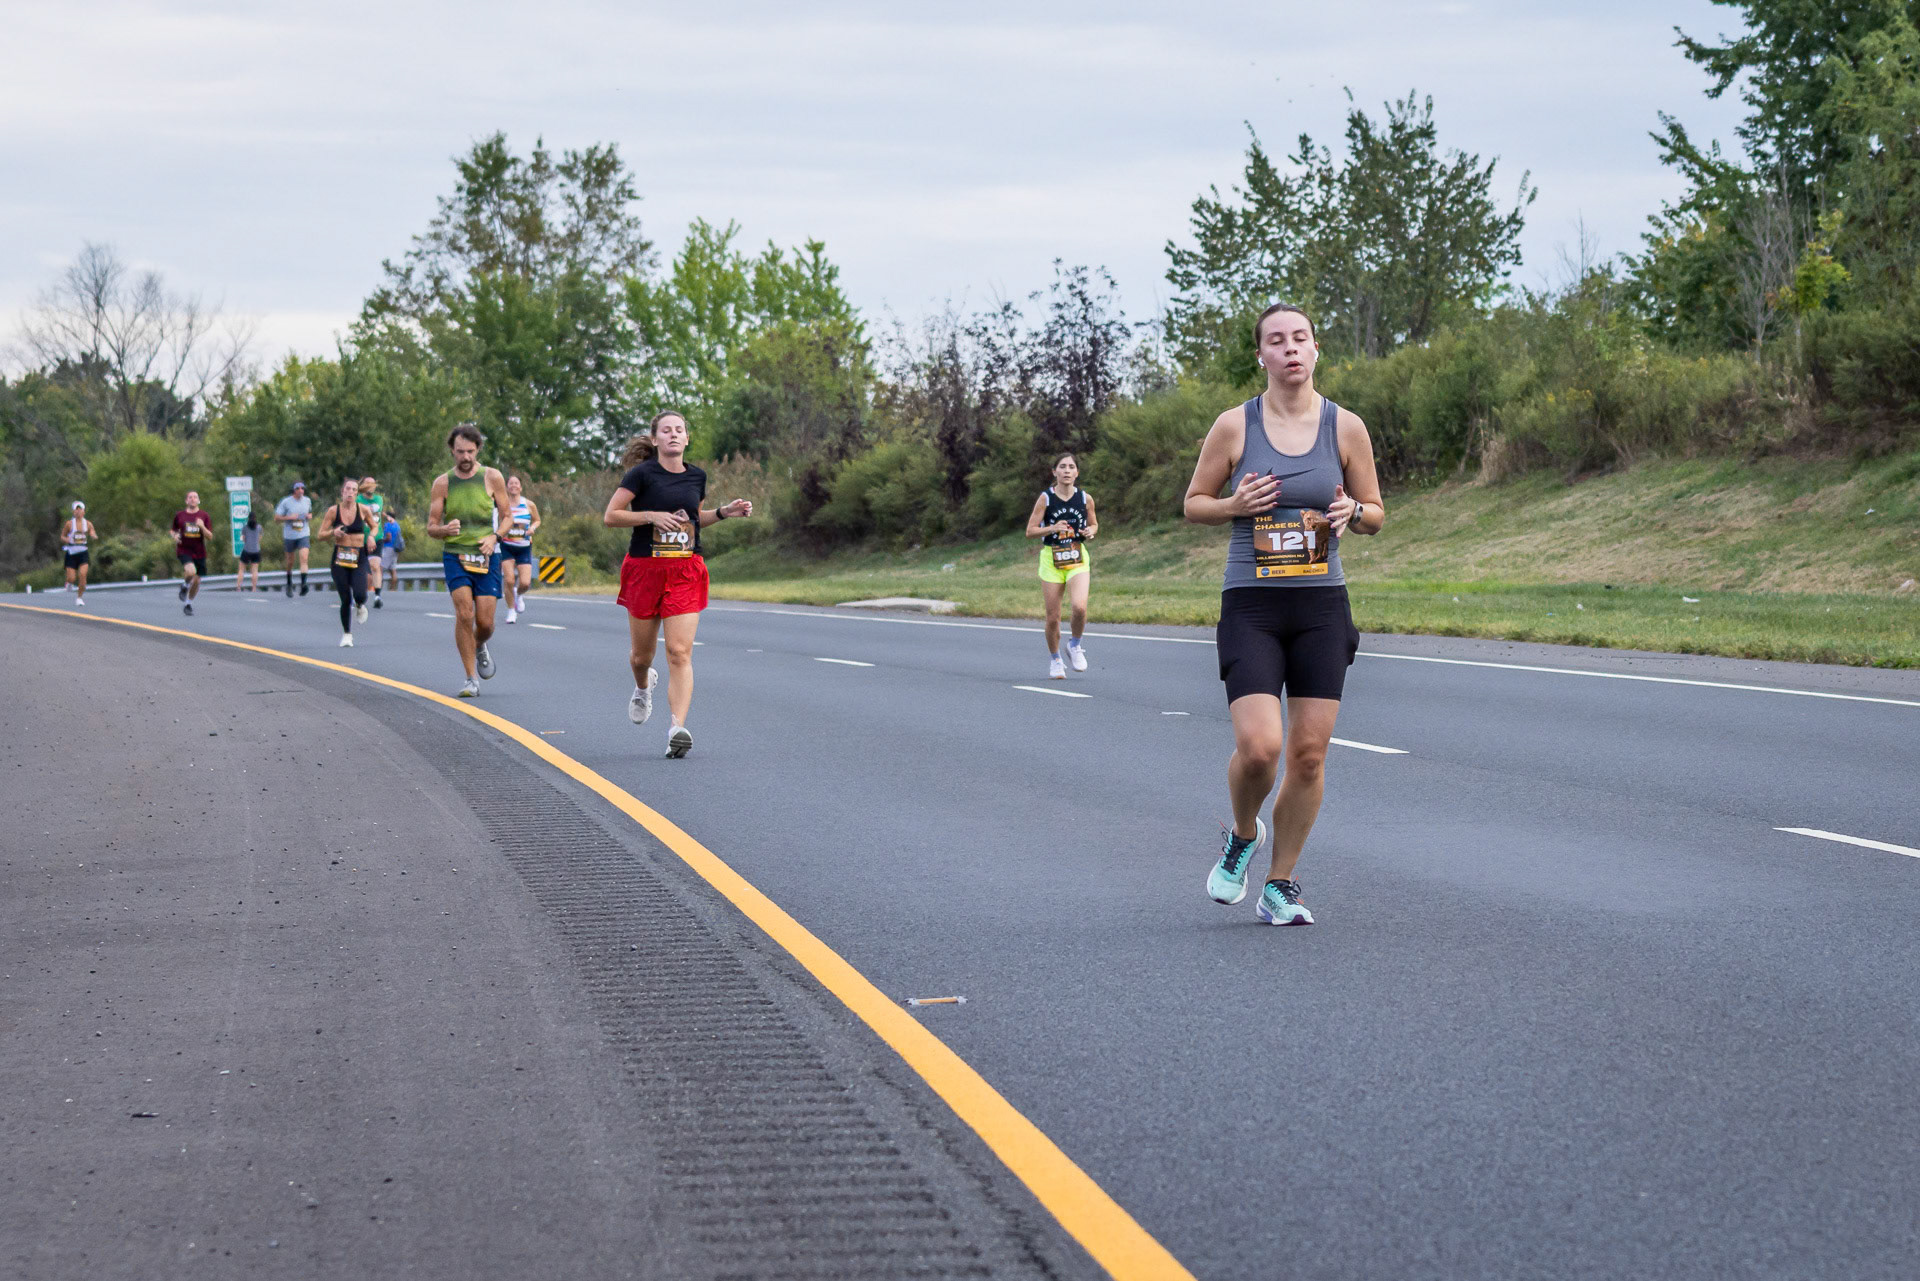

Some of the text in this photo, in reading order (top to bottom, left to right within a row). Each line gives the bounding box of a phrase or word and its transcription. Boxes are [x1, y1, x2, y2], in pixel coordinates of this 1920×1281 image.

[1053, 507, 1067, 518] MAD
[1254, 523, 1287, 531] CHASE
[659, 532, 689, 543] 170
[1268, 531, 1316, 551] 121
